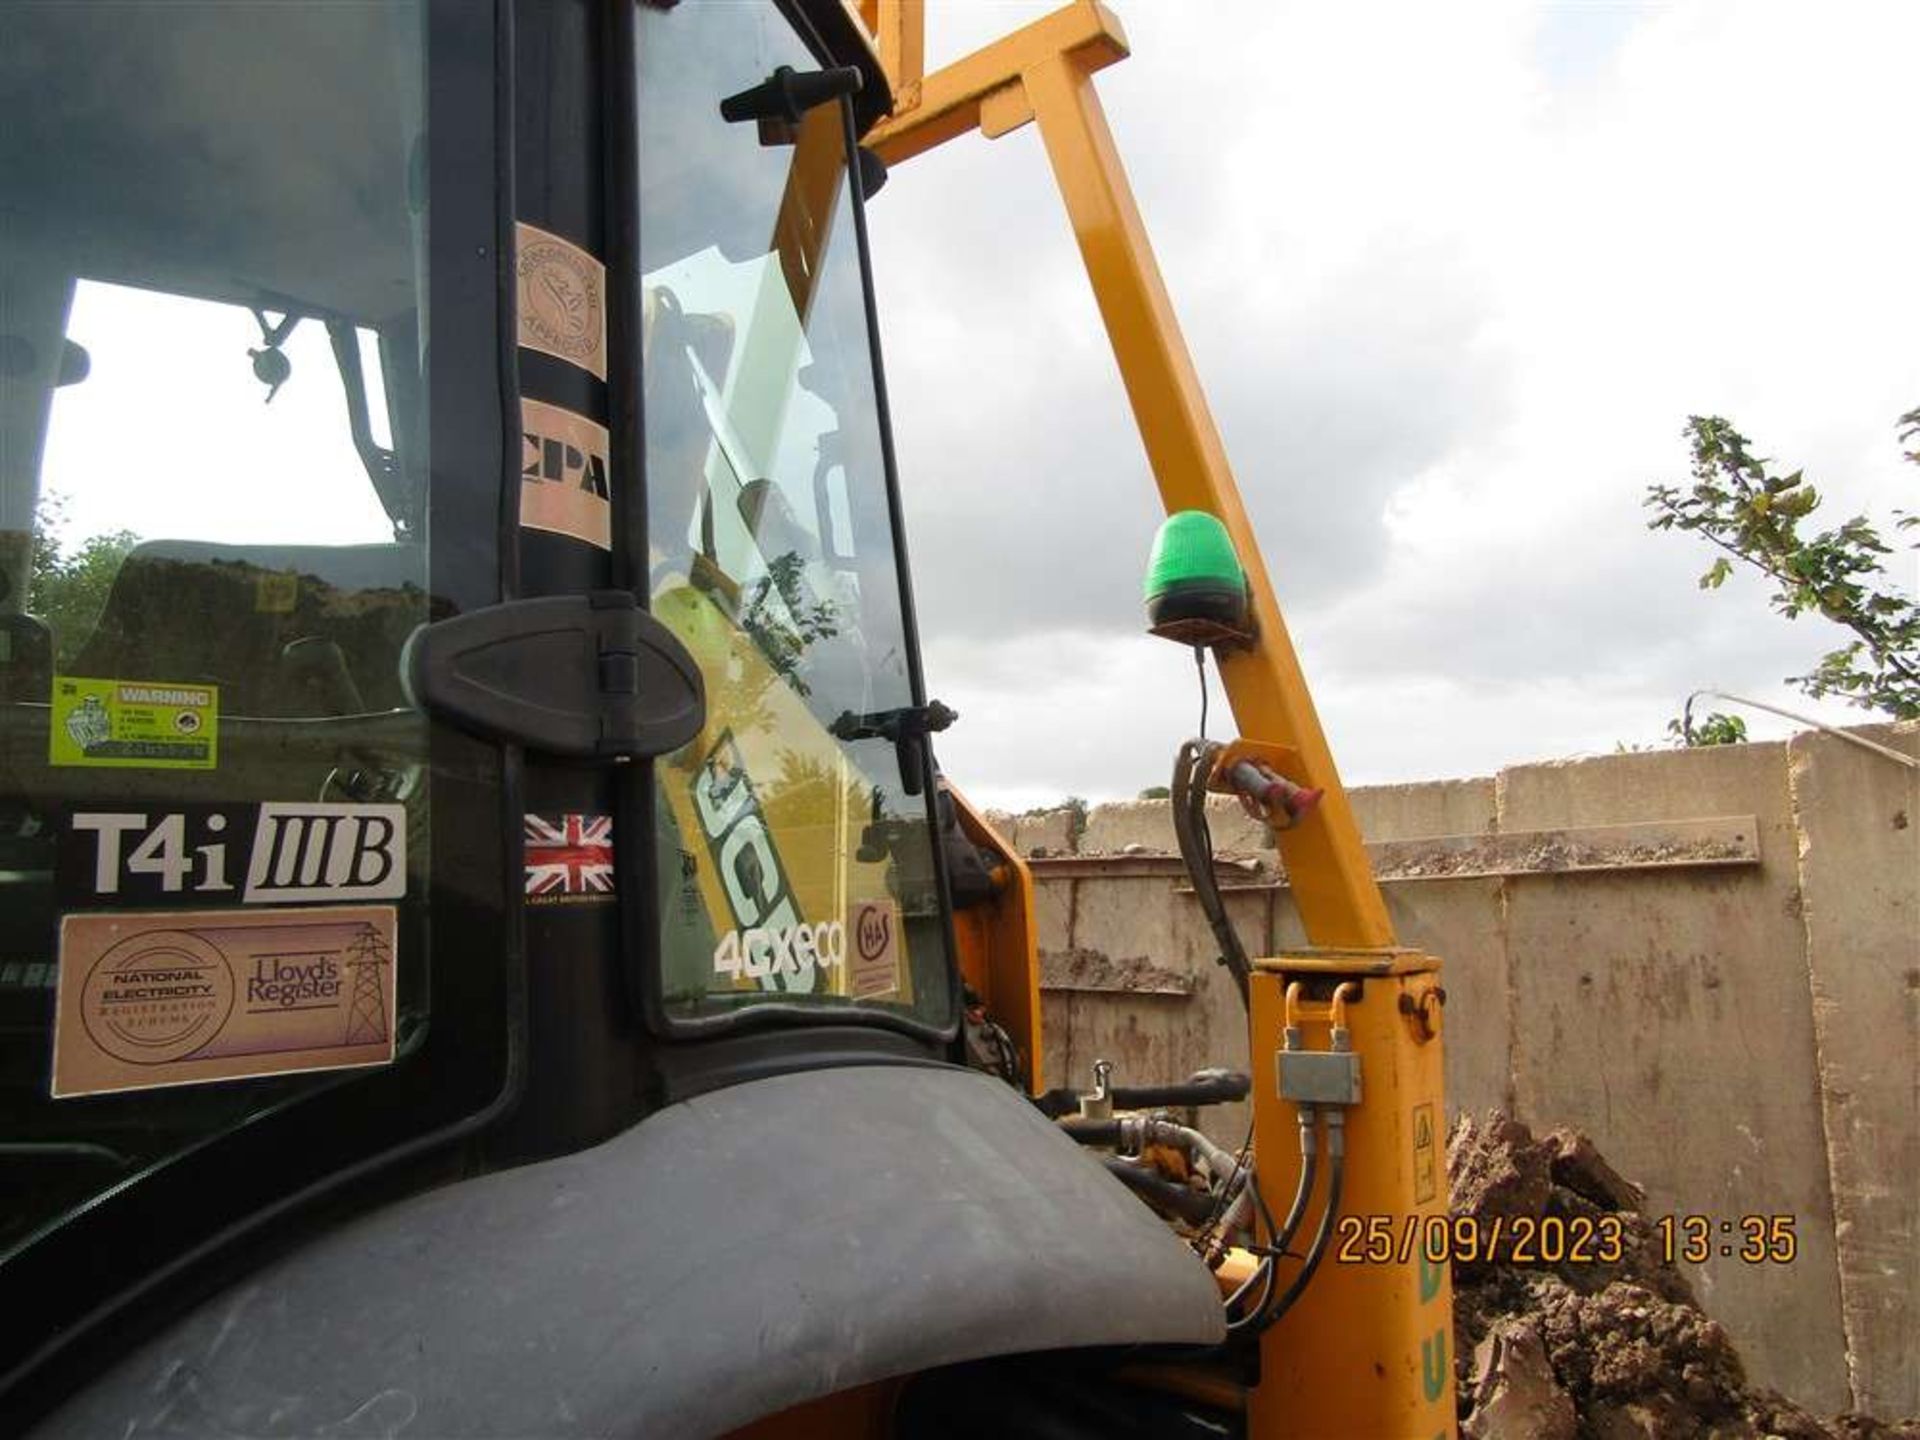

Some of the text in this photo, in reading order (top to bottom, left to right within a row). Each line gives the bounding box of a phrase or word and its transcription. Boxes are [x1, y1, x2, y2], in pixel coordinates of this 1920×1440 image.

[122, 687, 209, 706] WARNING
[72, 813, 235, 893] T4i
[113, 971, 203, 984] NATIONAL
[257, 956, 338, 988] Lloyd's
[103, 984, 212, 1000] ELECTRICITY
[247, 977, 343, 1007] Register
